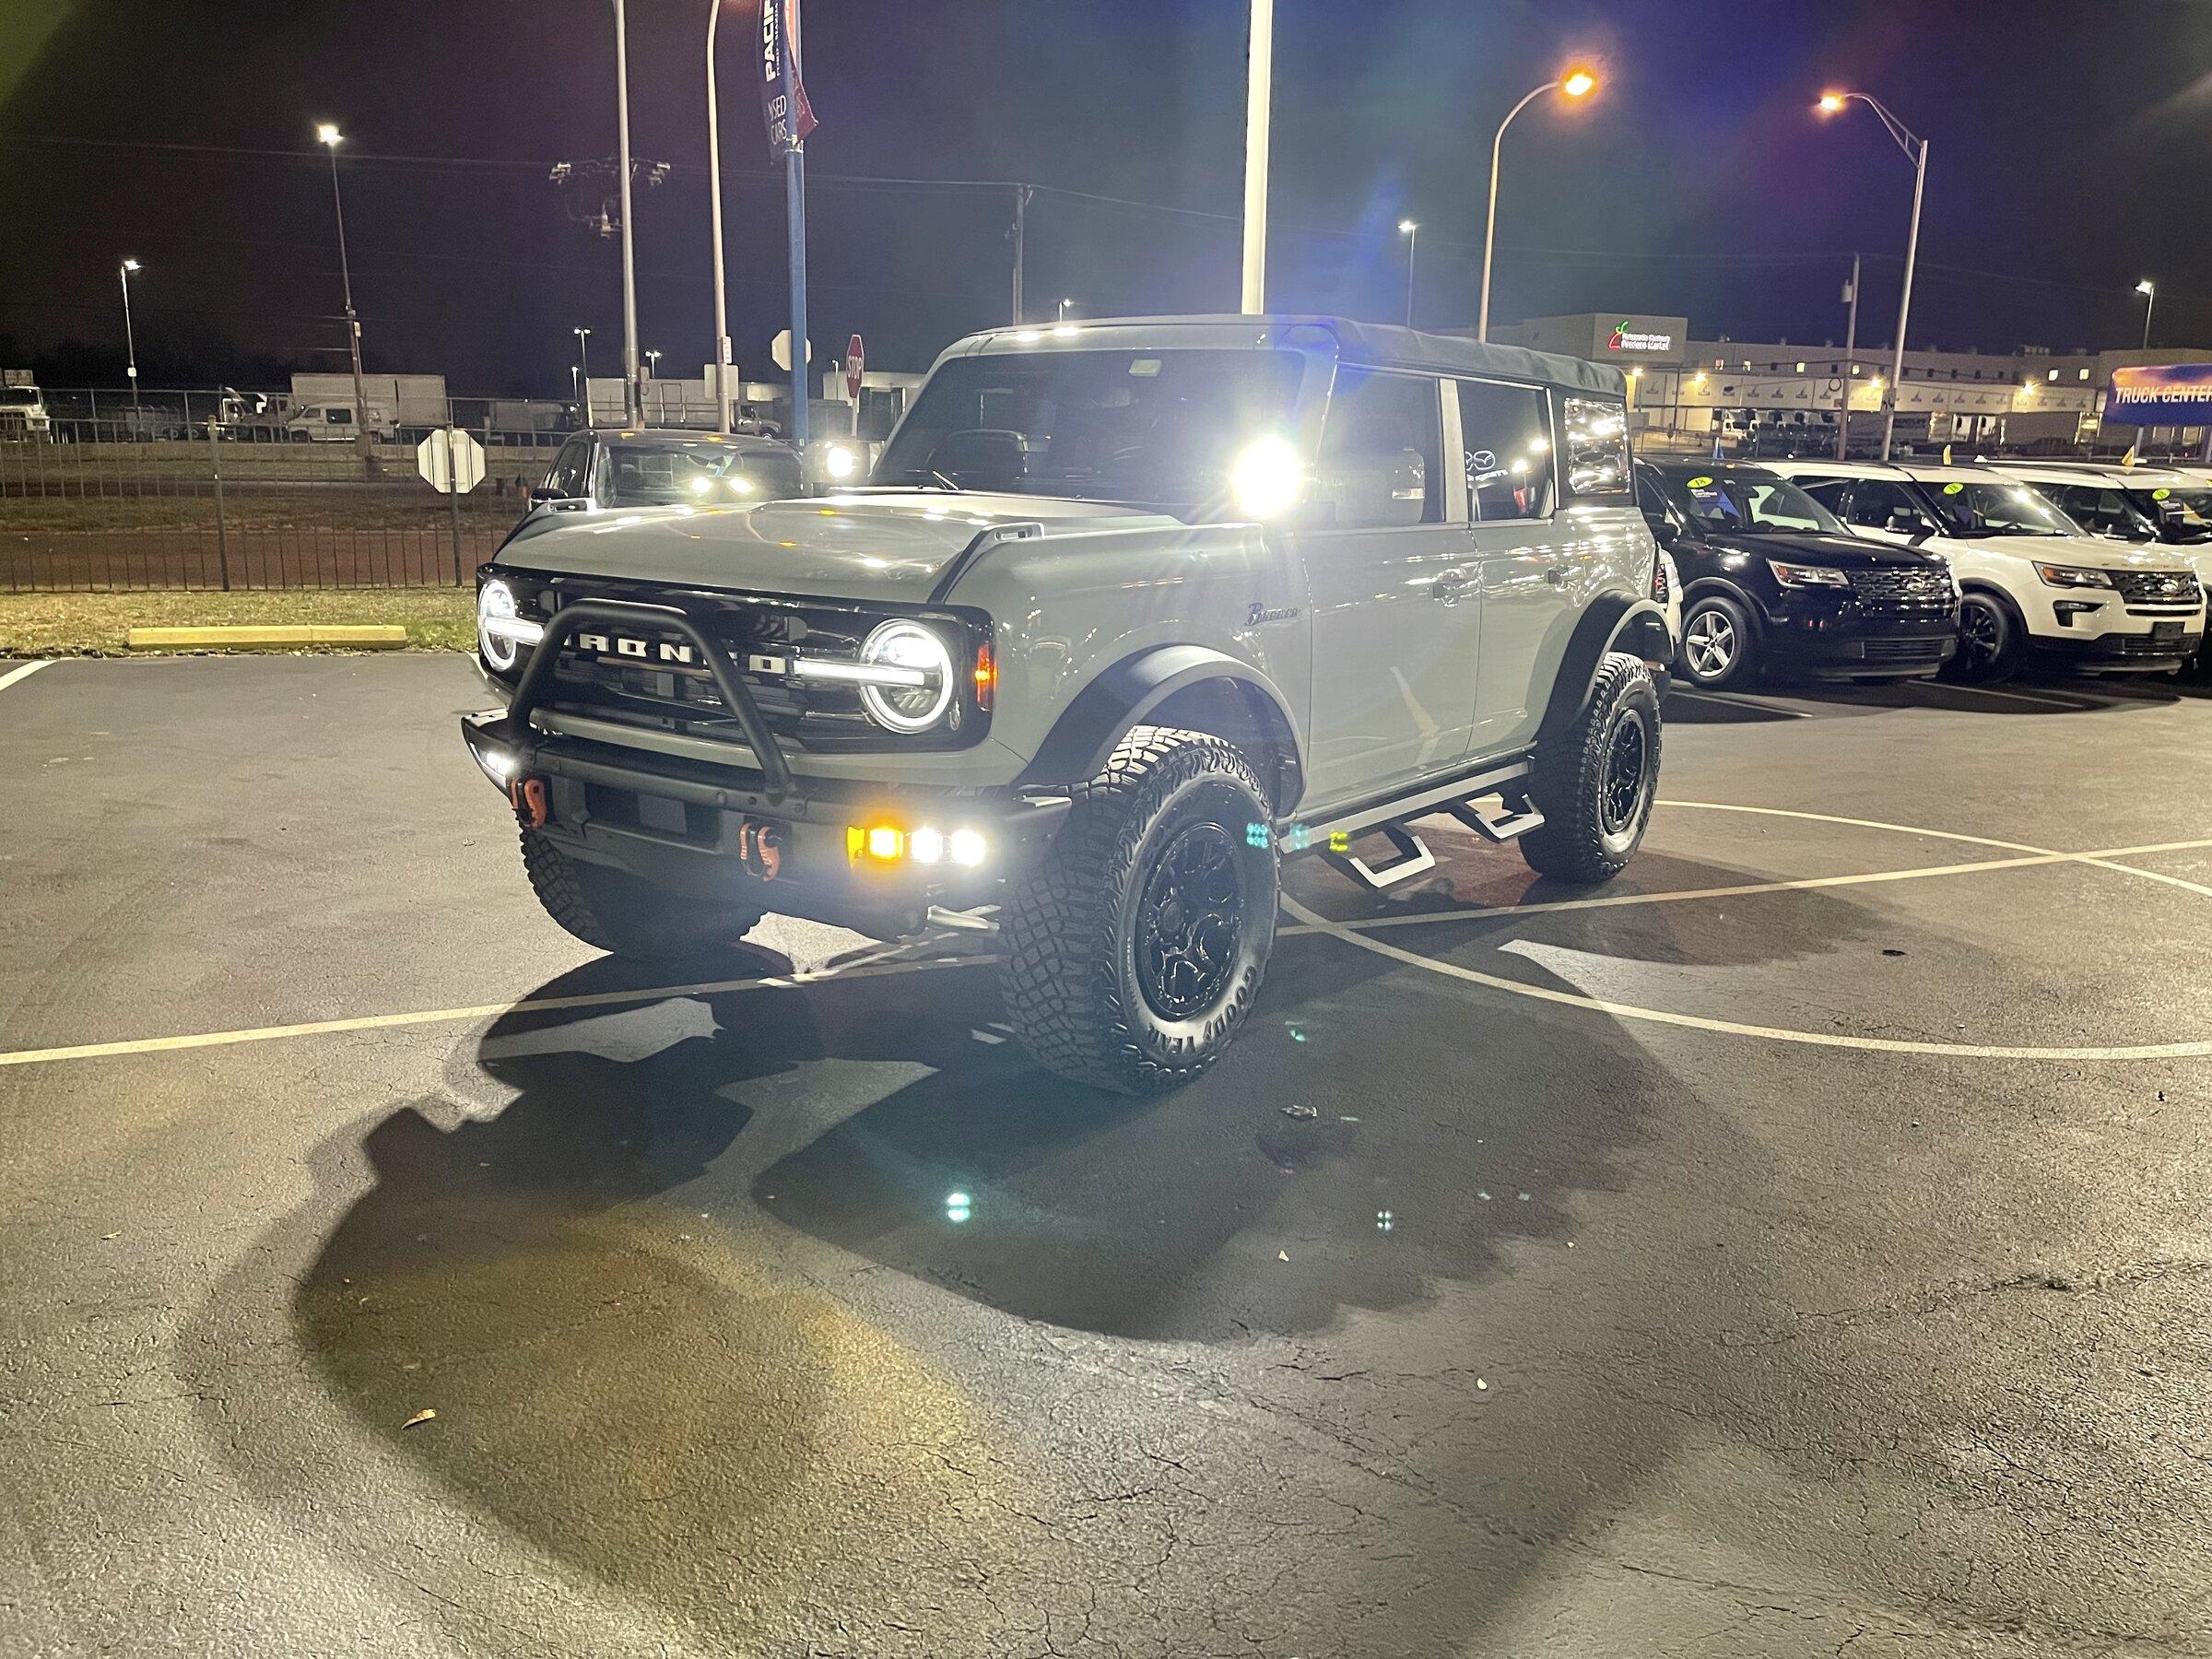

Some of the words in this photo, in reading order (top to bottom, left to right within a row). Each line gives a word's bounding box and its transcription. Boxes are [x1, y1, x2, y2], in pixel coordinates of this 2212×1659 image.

[847, 355, 862, 379] STOP
[2115, 386, 2159, 404] TRUCK
[562, 632, 786, 675] RONO
